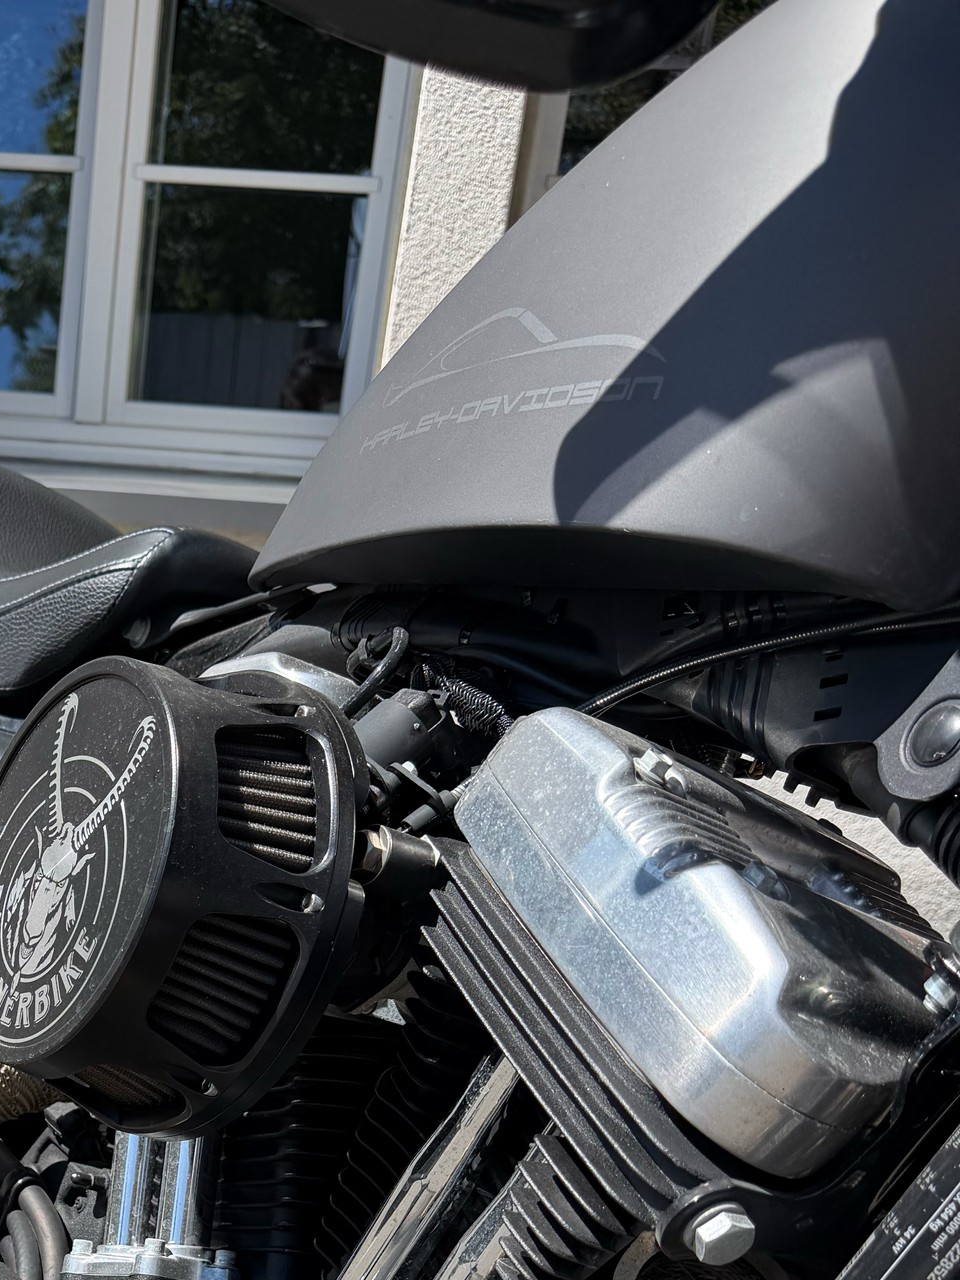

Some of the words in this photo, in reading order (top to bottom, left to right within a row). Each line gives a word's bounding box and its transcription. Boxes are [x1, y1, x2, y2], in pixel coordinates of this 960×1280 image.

[359, 376, 664, 454] HARLEY-DAVIDSON
[940, 1202, 957, 1220] 454
[929, 1218, 944, 1232] kg
[891, 1236, 906, 1254] kW
